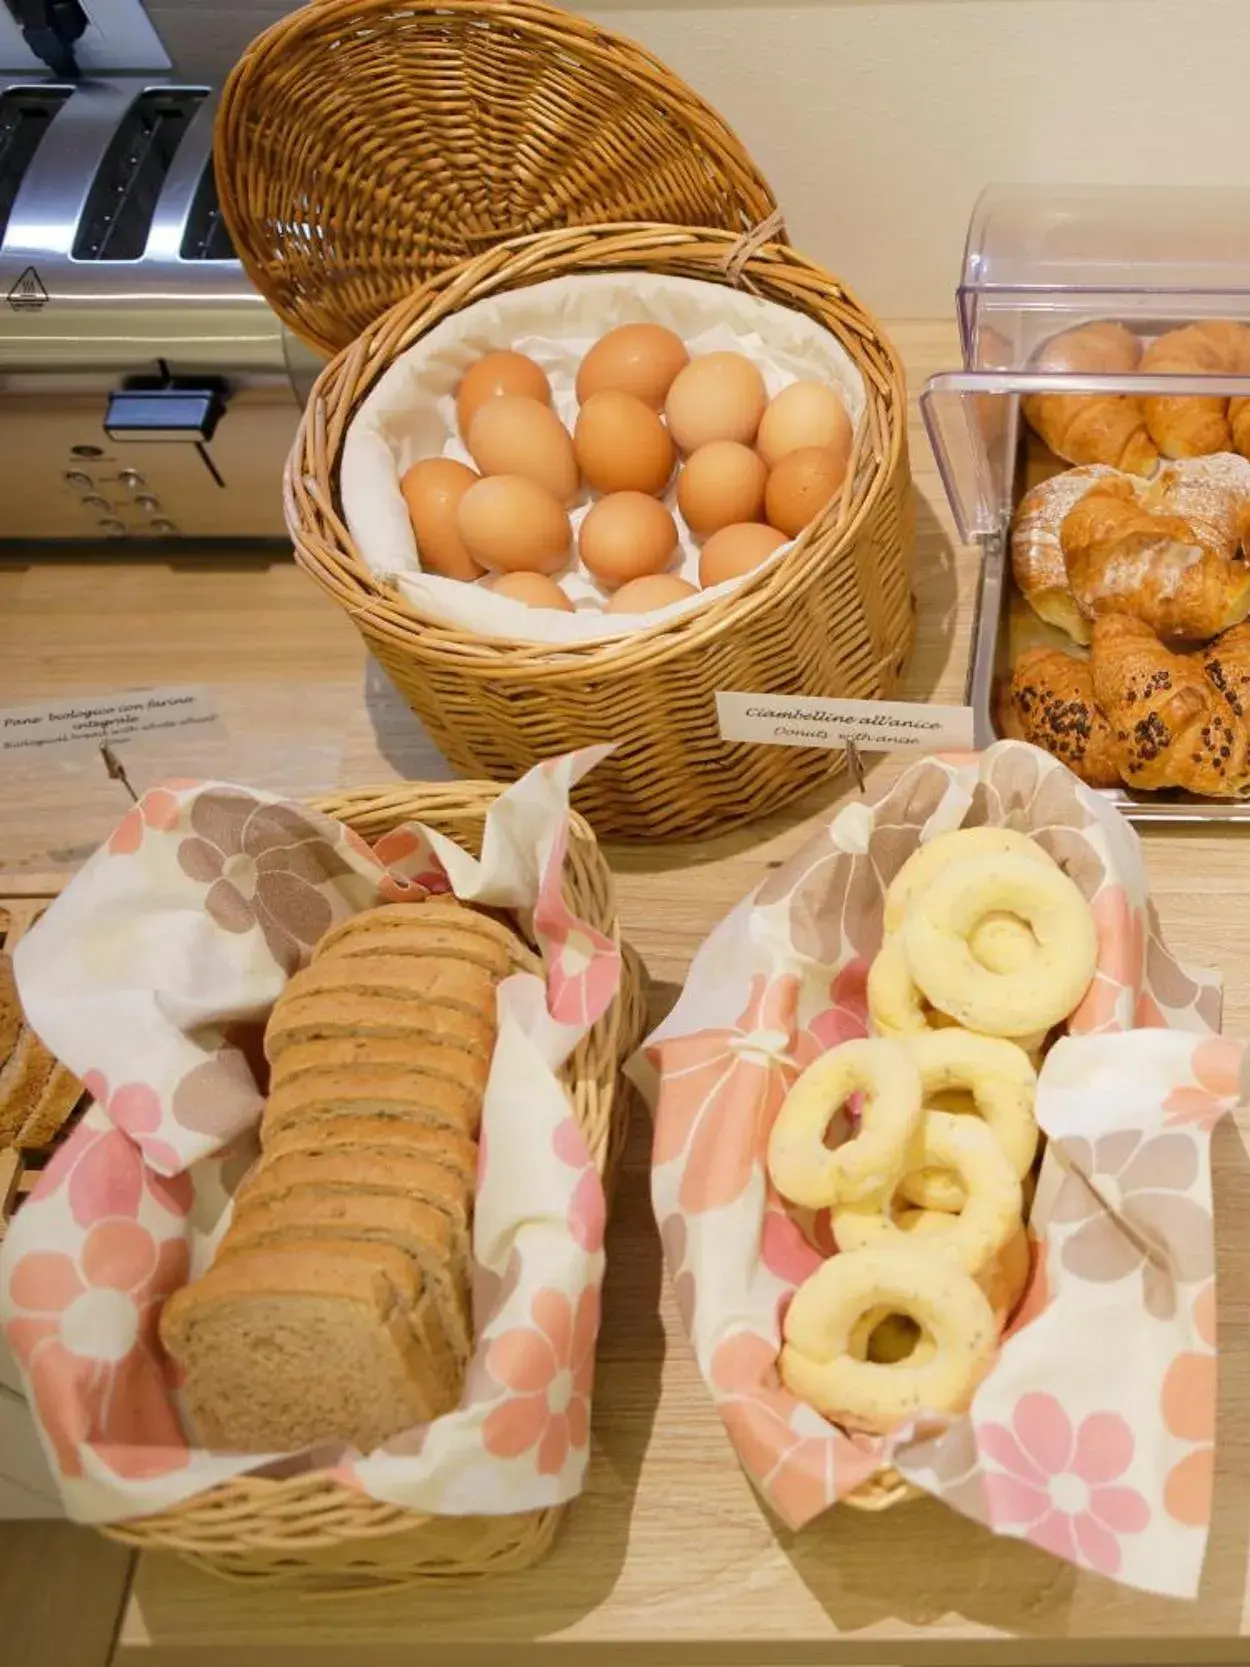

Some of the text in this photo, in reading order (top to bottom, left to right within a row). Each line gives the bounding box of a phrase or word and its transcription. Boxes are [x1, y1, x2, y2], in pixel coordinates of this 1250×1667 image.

[4, 697, 194, 728] Pane biologico con farina
[745, 706, 943, 730] Ciambelline all'anice
[774, 726, 828, 739] Donuts
[875, 736, 920, 745] anise
